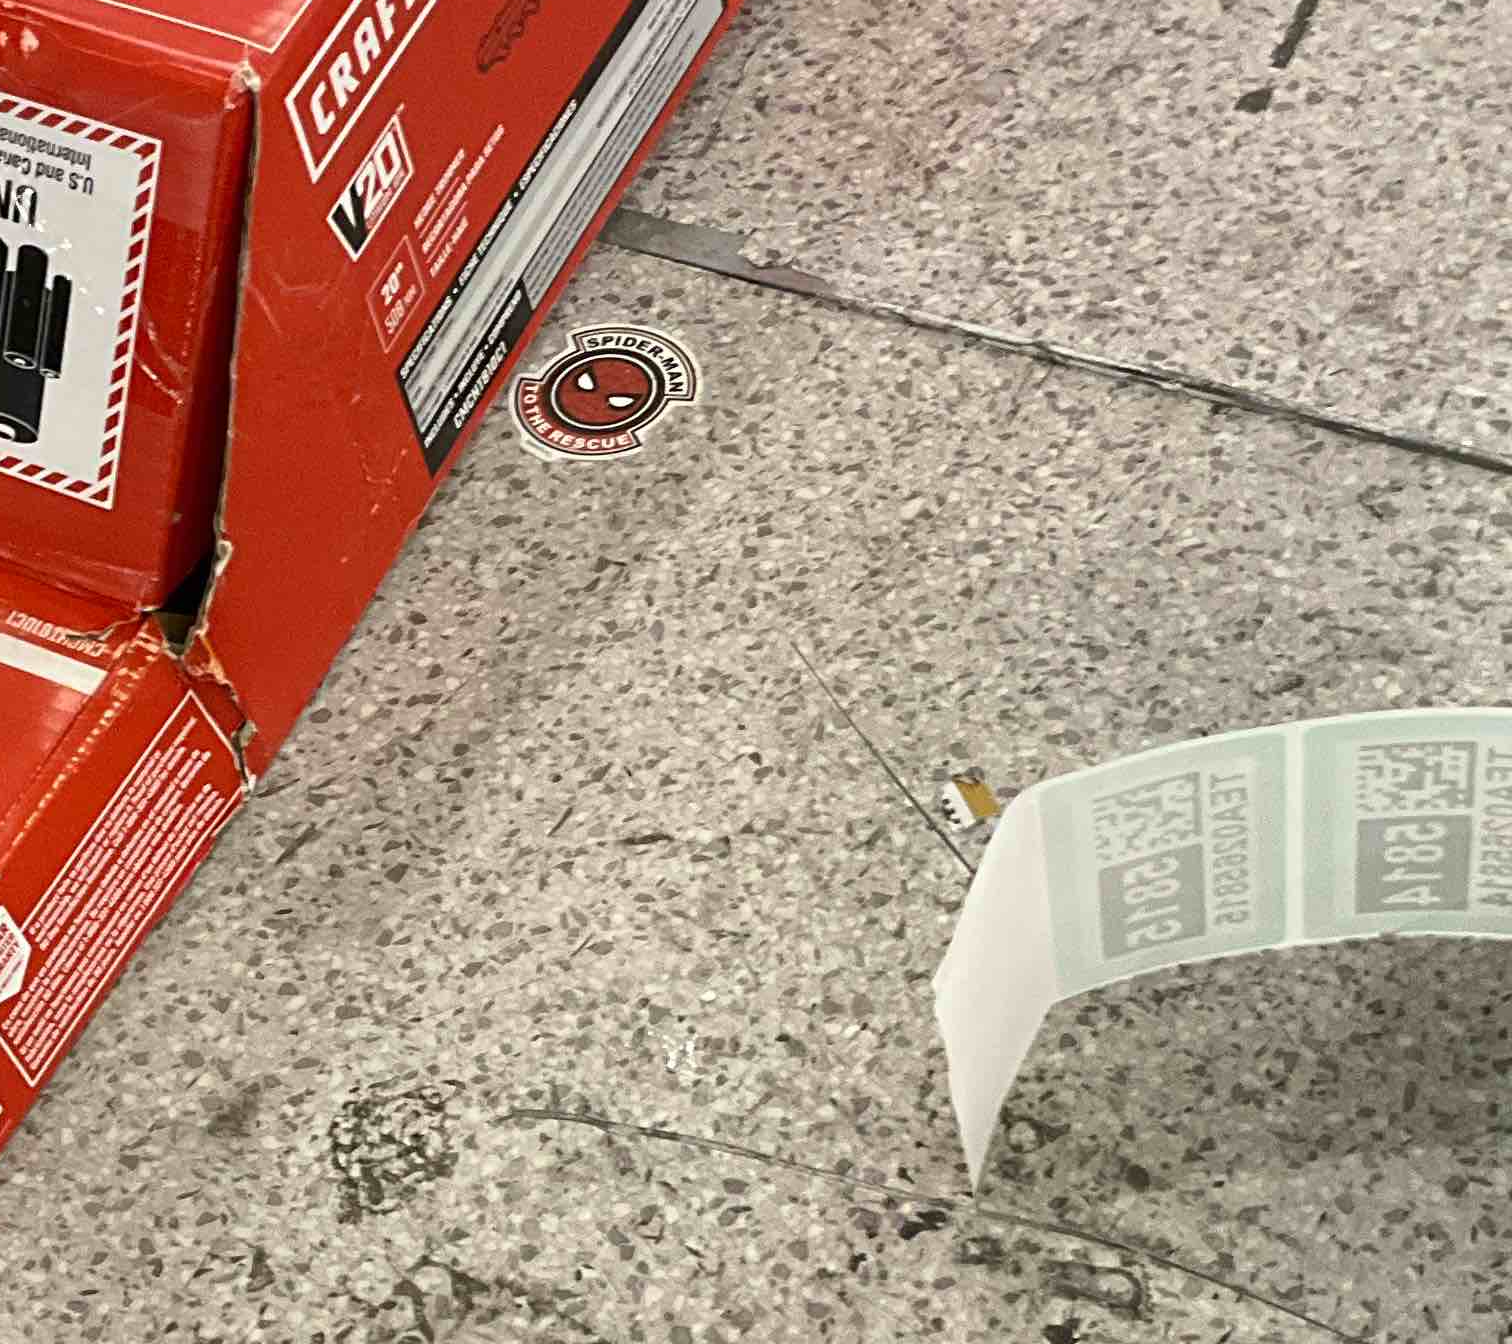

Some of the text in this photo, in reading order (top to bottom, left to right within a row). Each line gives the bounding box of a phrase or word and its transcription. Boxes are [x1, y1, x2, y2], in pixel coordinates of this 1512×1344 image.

[33, 160, 65, 183] and
[66, 170, 95, 195] U.S
[331, 125, 404, 255] V20
[380, 256, 404, 308] 20"
[586, 335, 684, 394] SPIDER-MAN
[523, 384, 633, 450] TO THE RESCUE
